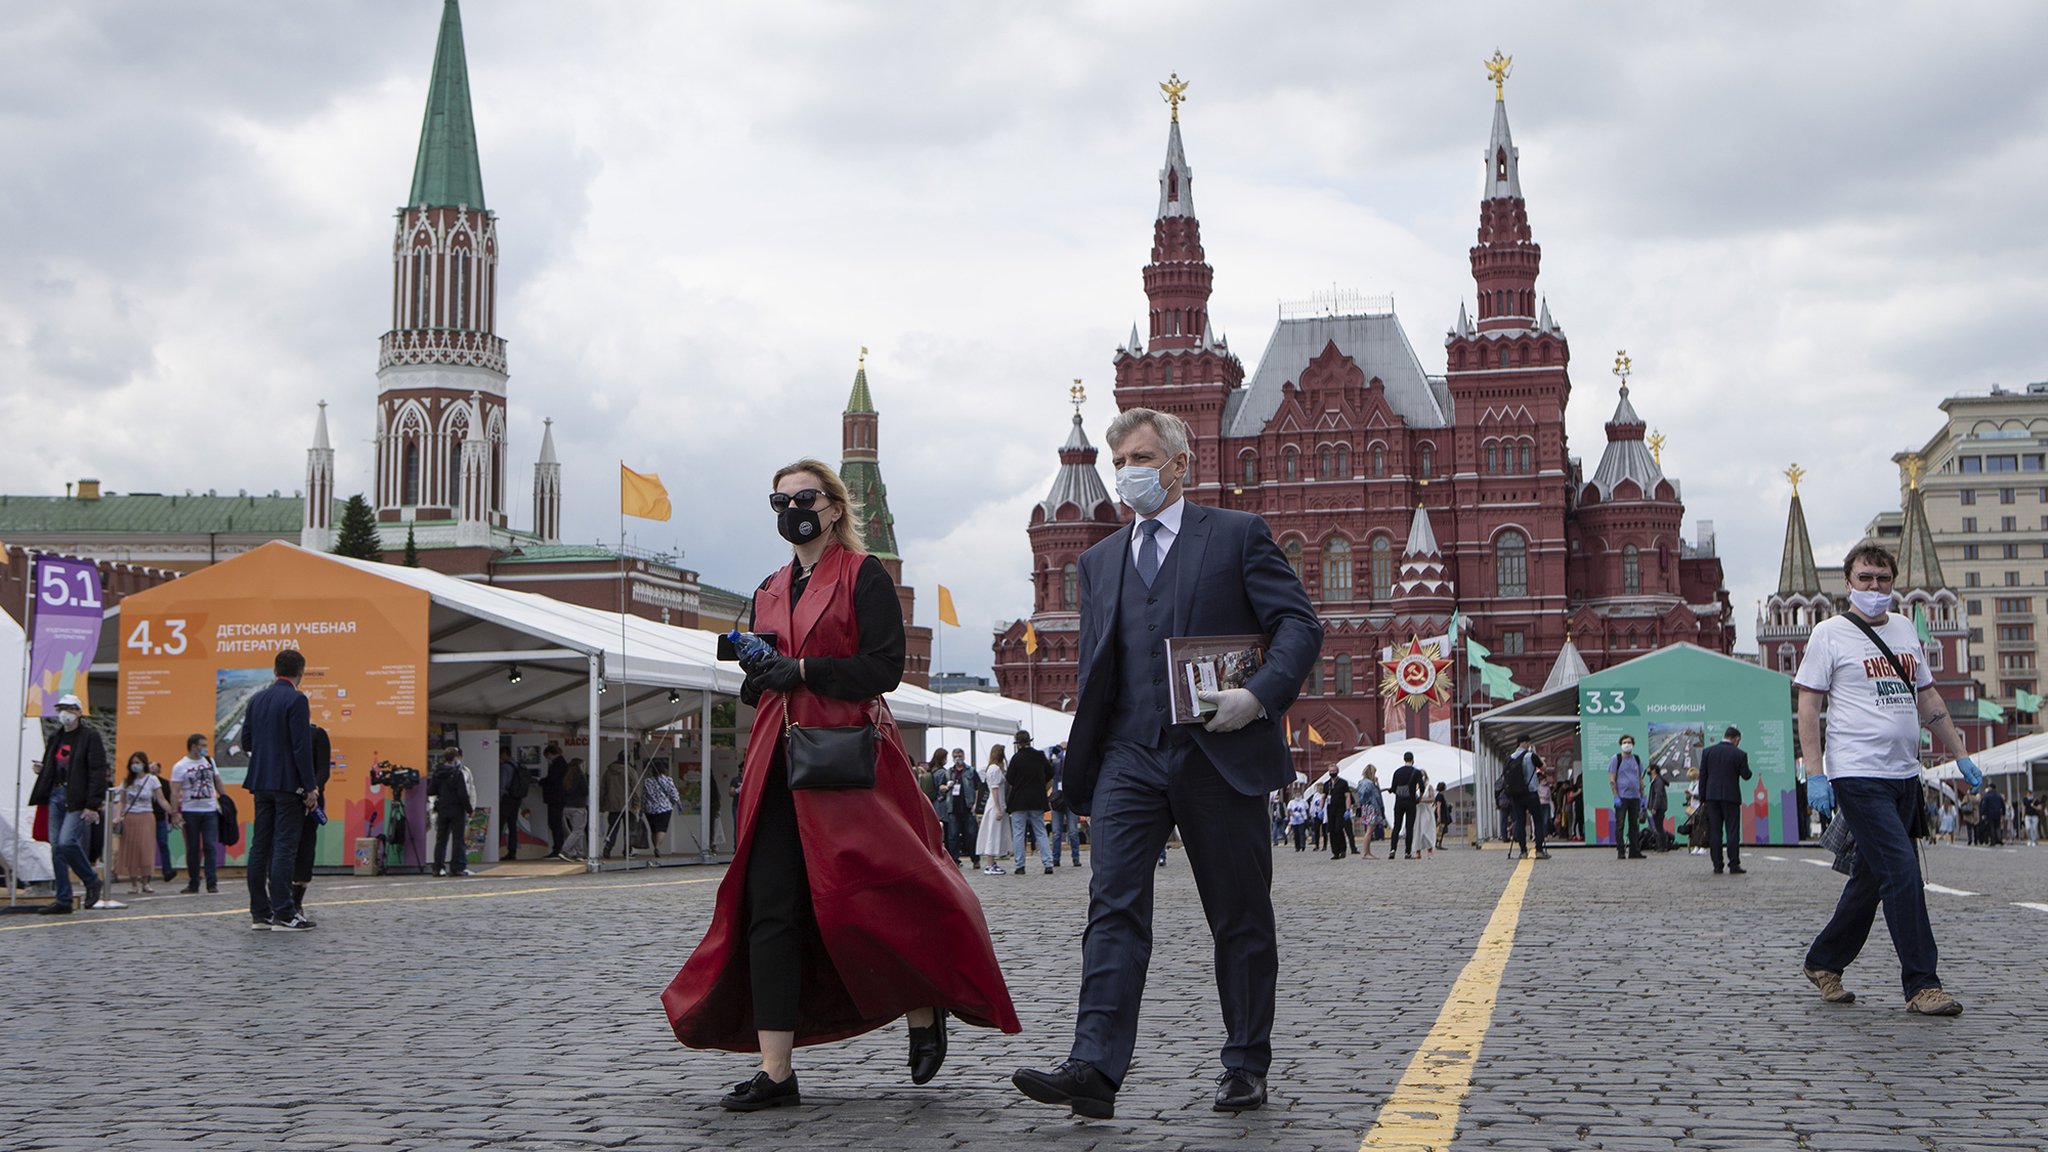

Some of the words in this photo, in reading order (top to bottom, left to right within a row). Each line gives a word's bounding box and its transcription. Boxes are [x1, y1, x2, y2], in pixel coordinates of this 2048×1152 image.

[42, 565, 101, 608] 5.1
[127, 619, 188, 656] 4.3
[216, 622, 278, 638] ДЕТСКАЯ
[280, 622, 291, 635] И
[294, 621, 357, 634] УЧЕБНАЯ
[216, 639, 301, 653] ЛИТЕРАТУРА
[1586, 691, 1626, 714] 3.3
[1646, 703, 1706, 713] НОН-ФИКШН
[565, 737, 590, 746] КАСС
